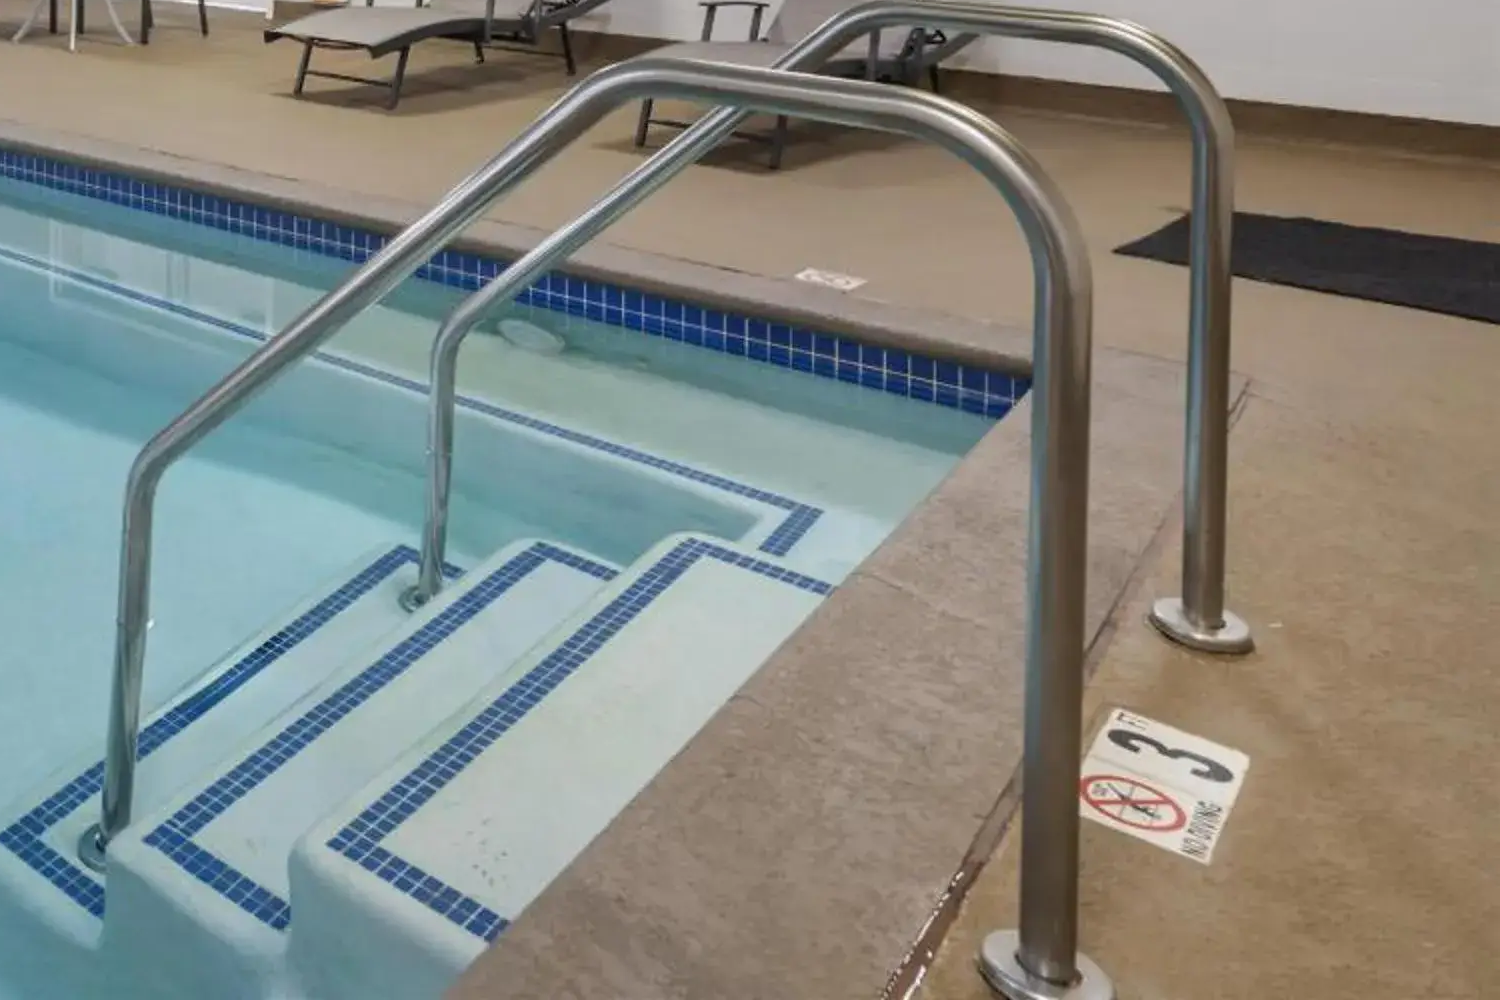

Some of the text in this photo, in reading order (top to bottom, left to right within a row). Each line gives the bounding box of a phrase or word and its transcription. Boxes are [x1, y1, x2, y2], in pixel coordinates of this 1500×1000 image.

[1108, 729, 1234, 784] 3
[1181, 801, 1223, 857] NO DIVING
